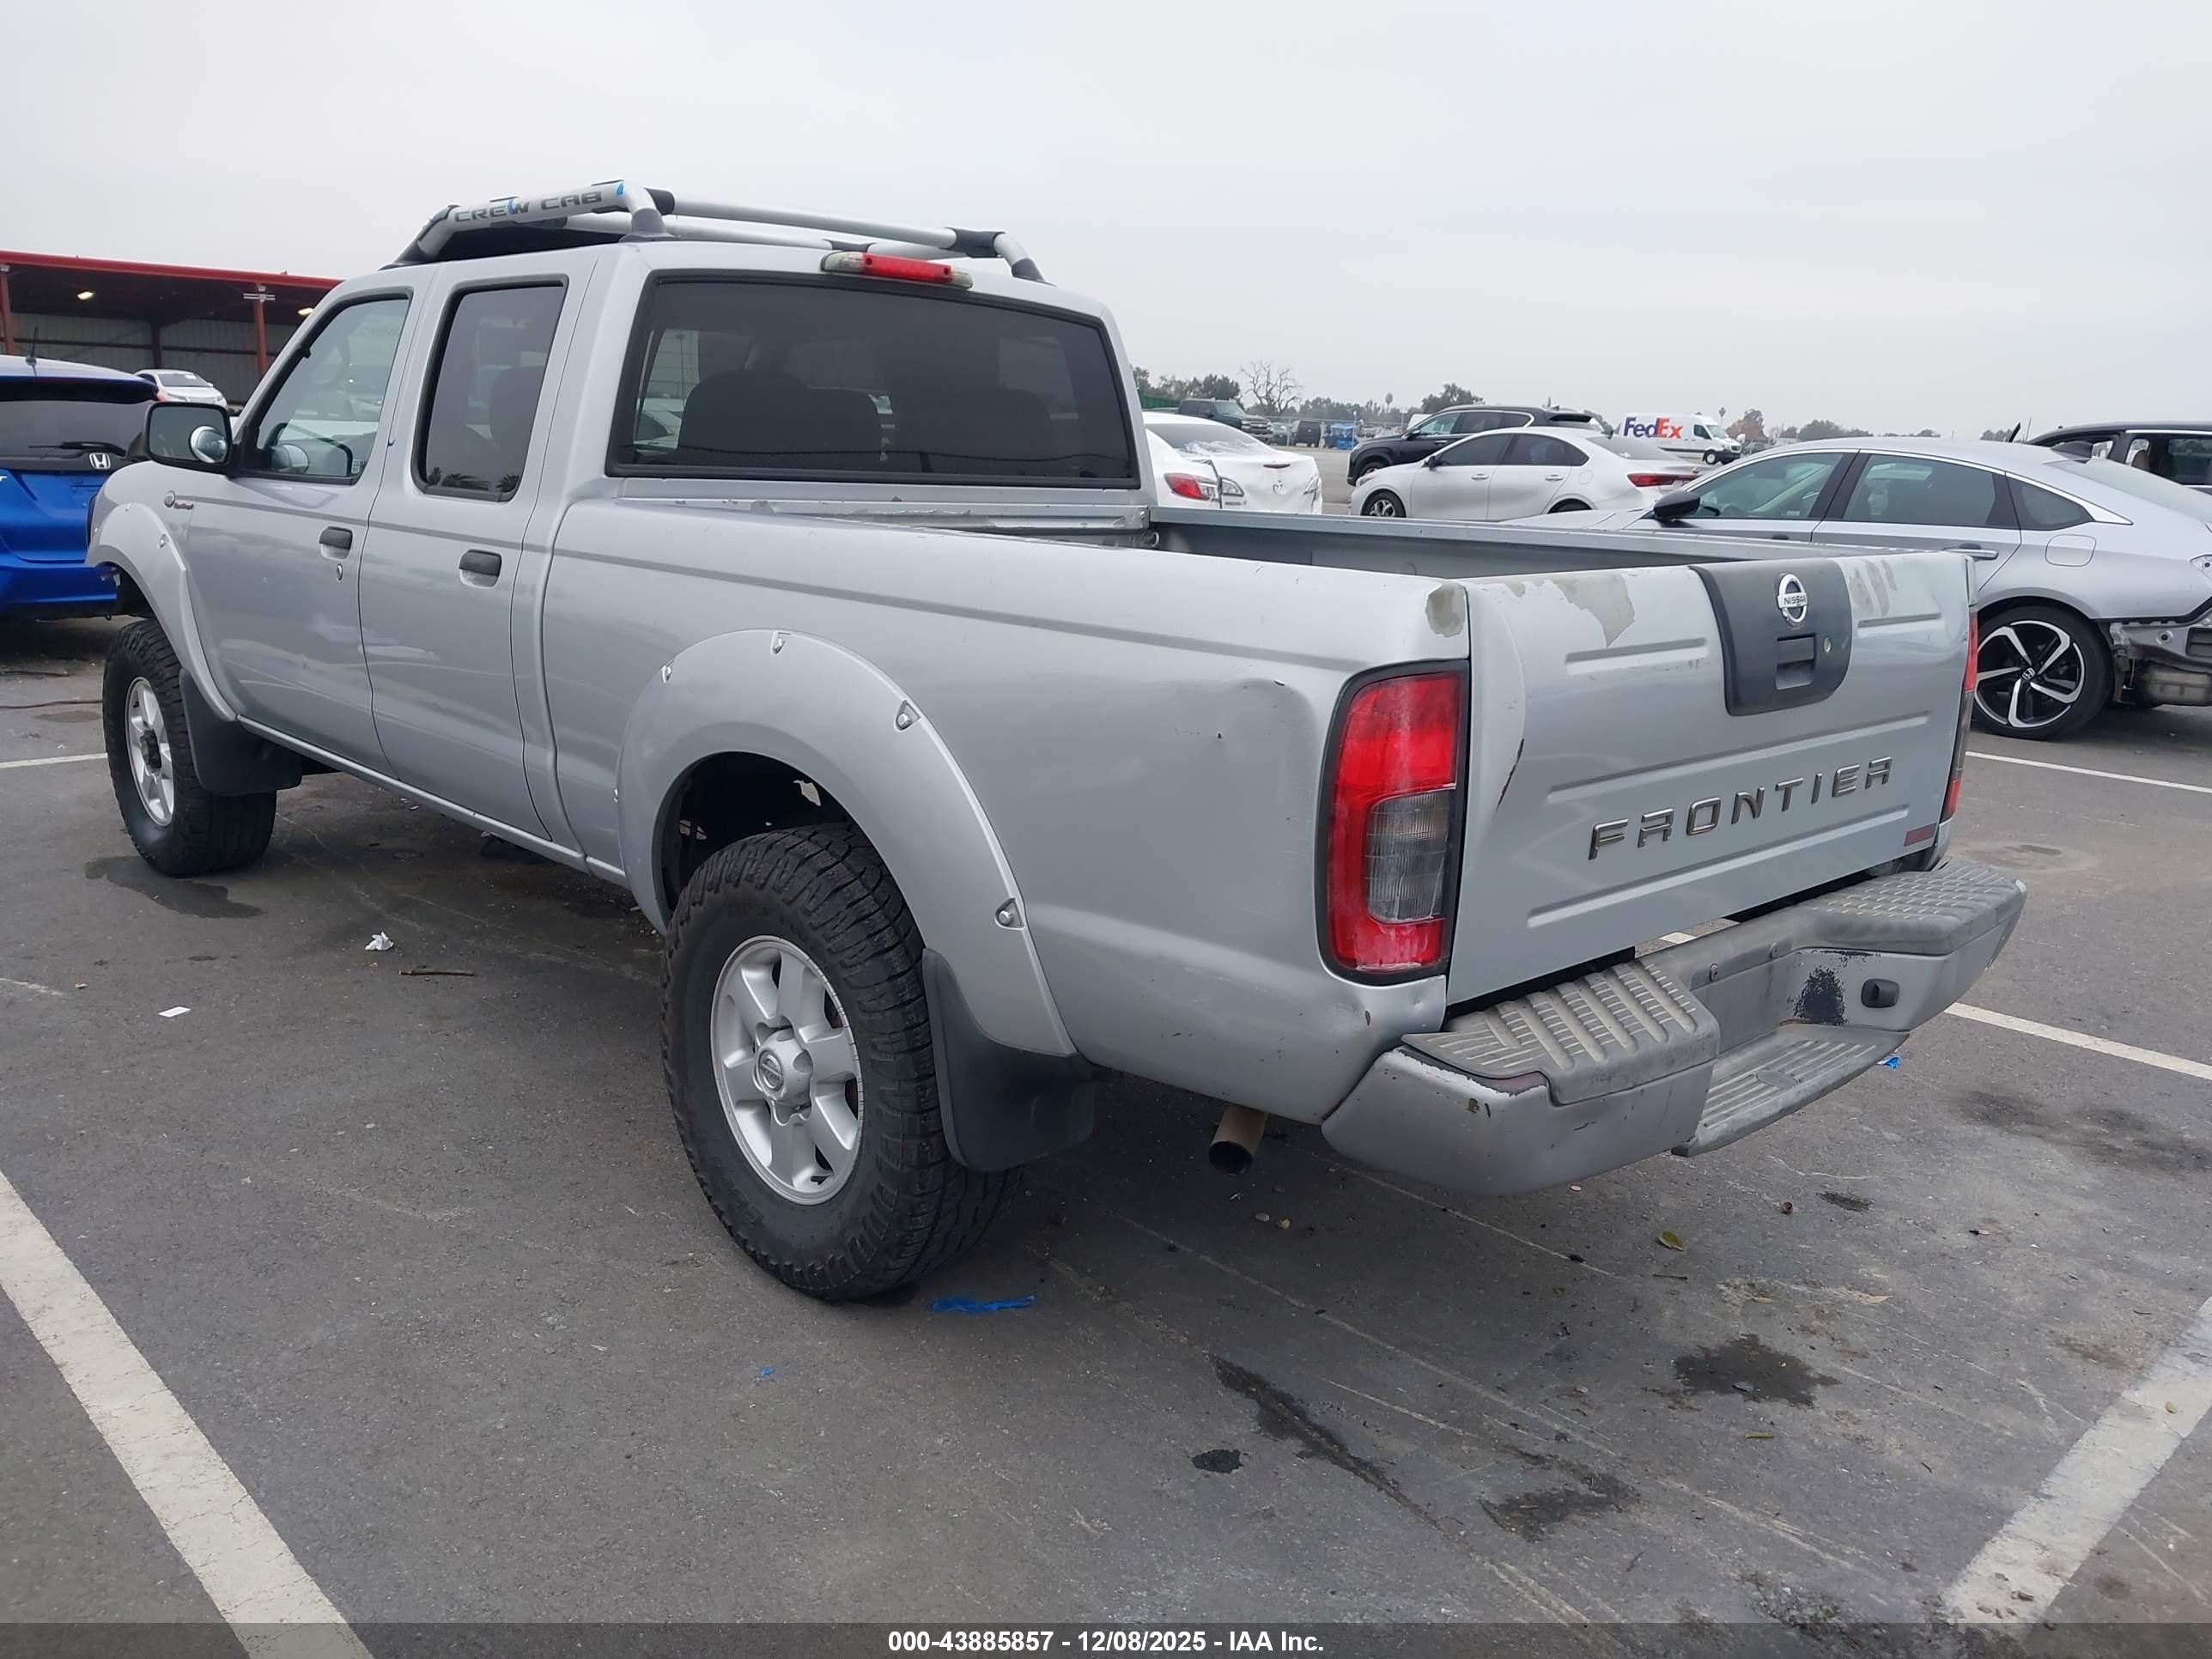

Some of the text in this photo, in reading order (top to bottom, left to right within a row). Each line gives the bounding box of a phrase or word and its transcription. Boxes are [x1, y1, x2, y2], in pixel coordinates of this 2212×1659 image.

[455, 191, 602, 222] CREW CAB
[1624, 417, 1683, 439] FedEx
[1589, 757, 1892, 860] FRONTIER
